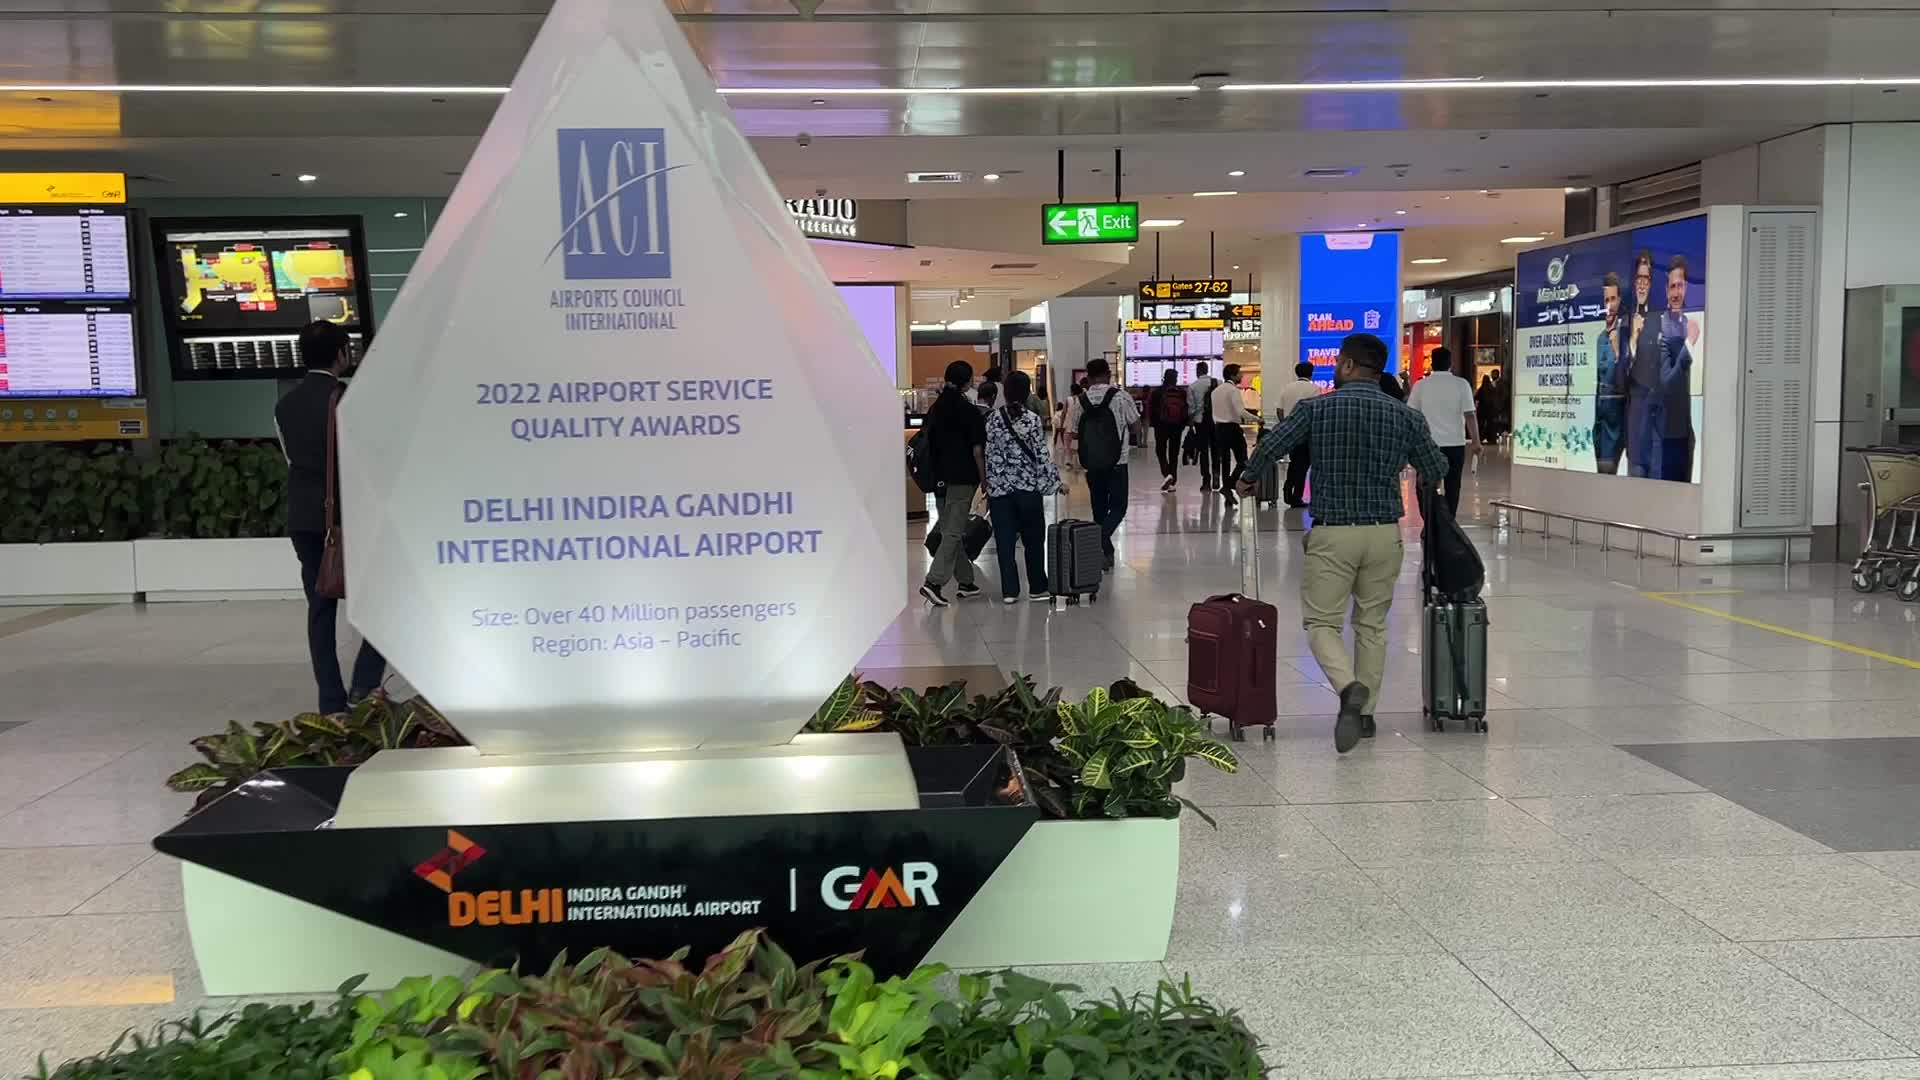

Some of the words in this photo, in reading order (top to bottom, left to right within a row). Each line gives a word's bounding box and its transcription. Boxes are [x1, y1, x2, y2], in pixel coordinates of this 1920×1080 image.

[568, 140, 664, 256] ACI
[1103, 214, 1131, 229] Exit
[550, 289, 618, 308] AIRPORTS
[623, 288, 686, 307] COUNCIL
[1172, 282, 1193, 291] Gates
[1194, 281, 1229, 293] 27-62
[565, 311, 678, 330] INTERNATIONAL
[1308, 313, 1332, 321] PLAN
[1308, 319, 1354, 331] AHEAD
[476, 383, 541, 404] 2022
[547, 381, 660, 403] AIRPORT
[667, 378, 774, 402] SERVICE
[511, 416, 624, 442] QUALITY
[629, 414, 741, 438] AWARDS
[463, 497, 553, 523] DELHI
[563, 494, 669, 521] INDIRA
[675, 491, 793, 518] GANDHI
[437, 533, 689, 564] INTERNATIONAL
[695, 529, 823, 558] AIRPORT
[471, 608, 519, 628] Size:
[524, 607, 573, 626] Over
[578, 605, 605, 624] 40
[611, 602, 679, 623] Million
[685, 600, 797, 624] passengers
[532, 634, 608, 657] Region:
[613, 632, 654, 650] Asia
[677, 628, 741, 648] Pacific
[567, 887, 623, 903] INDIRA
[820, 861, 940, 911] GMR
[448, 889, 564, 927] DELHI
[567, 903, 691, 921] INTERNATIONAL
[693, 900, 762, 916] AIRPORT
